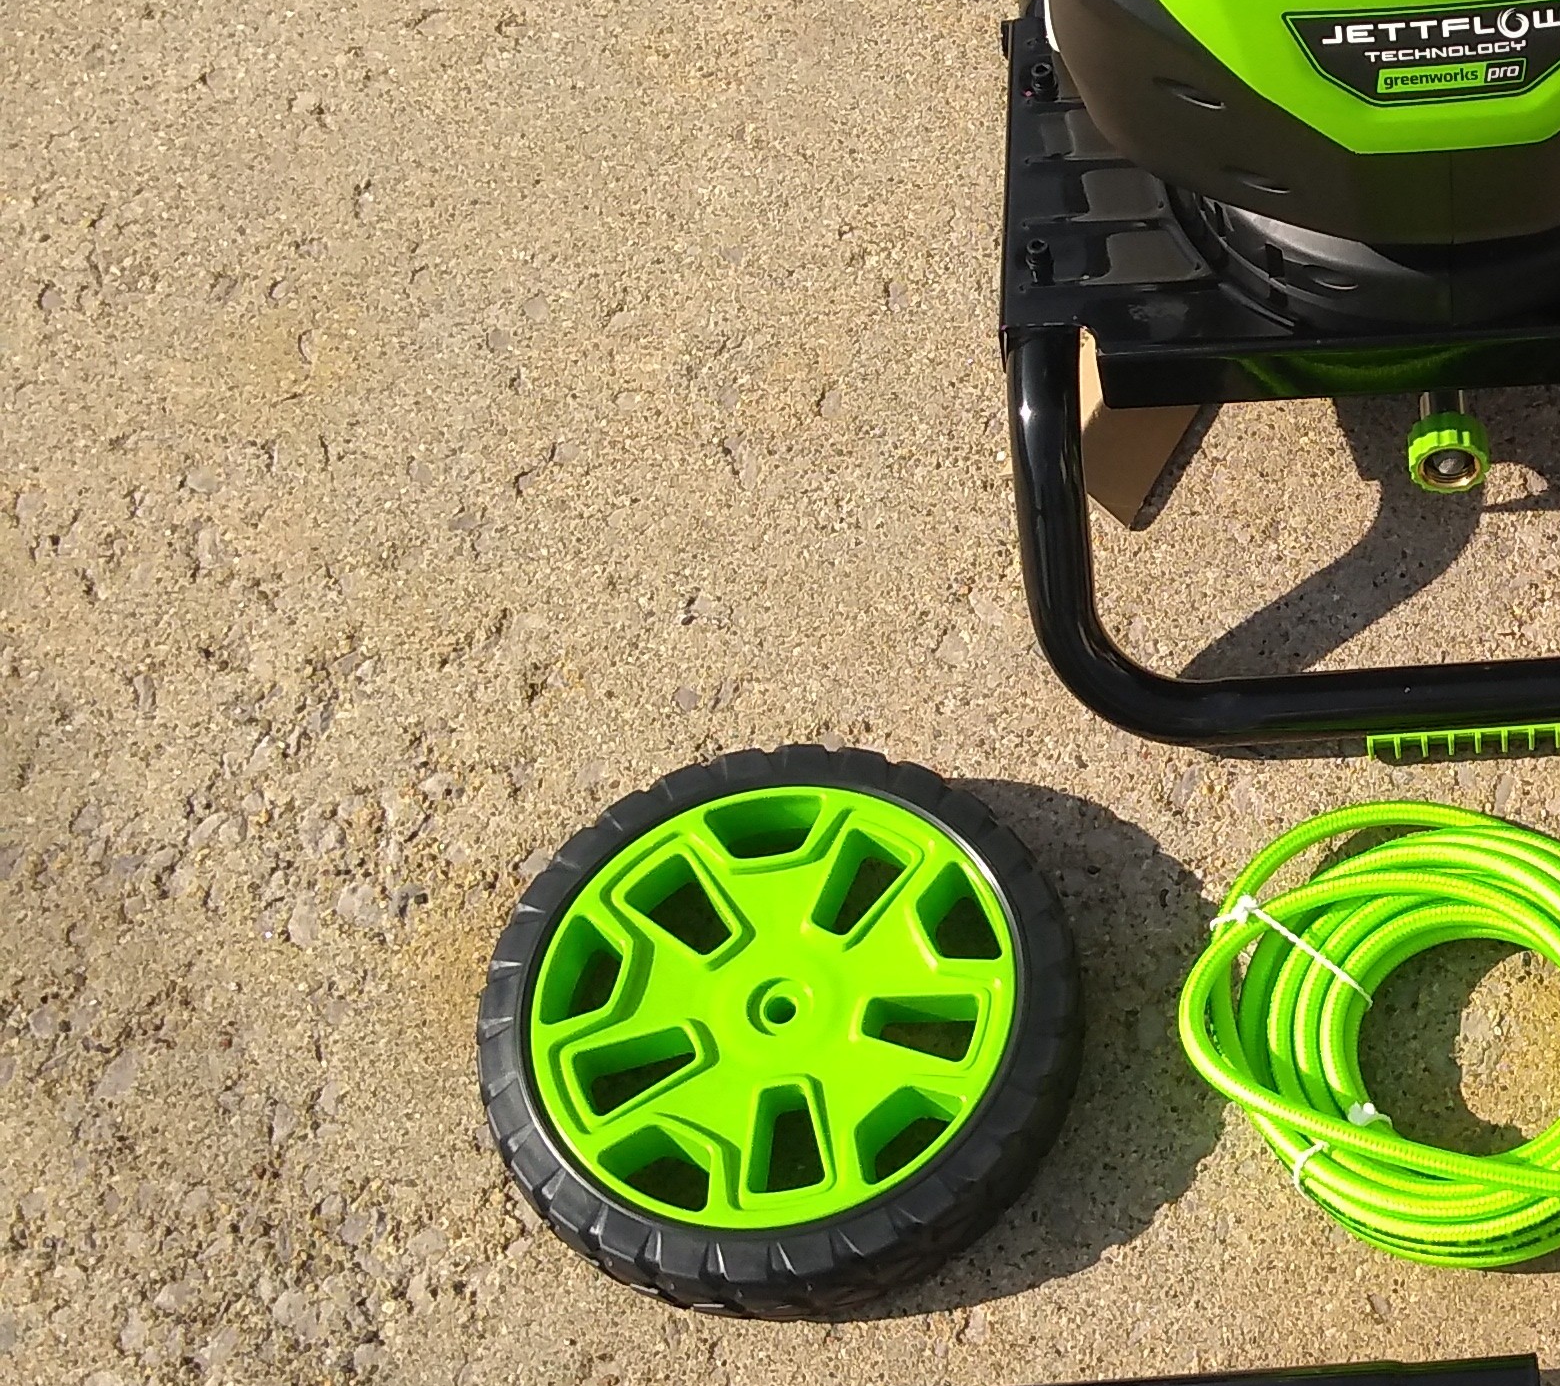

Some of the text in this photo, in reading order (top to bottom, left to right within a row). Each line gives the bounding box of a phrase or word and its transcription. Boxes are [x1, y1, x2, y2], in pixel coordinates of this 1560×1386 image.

[1364, 40, 1527, 63] TECHNOLOGY
[1383, 64, 1520, 89] greenworks pro
